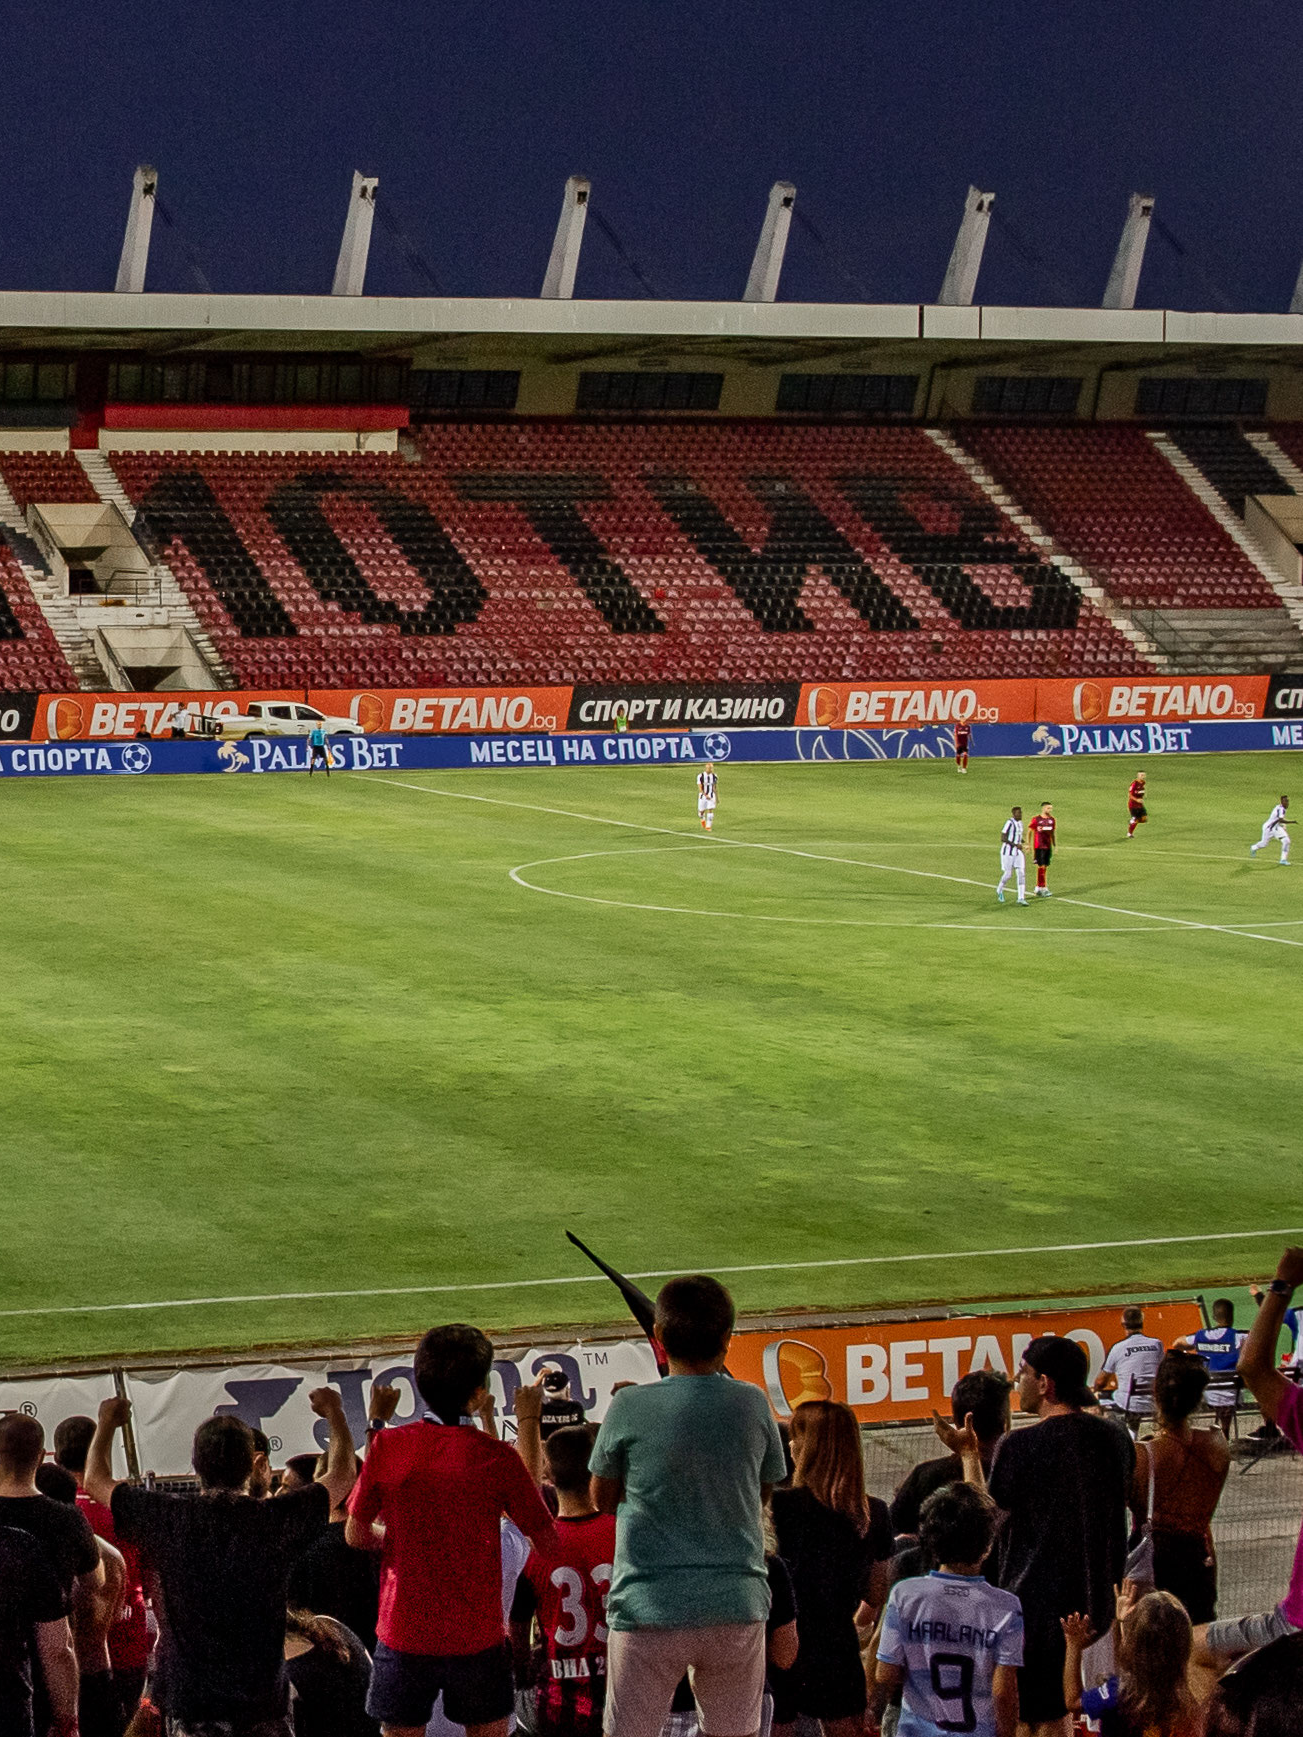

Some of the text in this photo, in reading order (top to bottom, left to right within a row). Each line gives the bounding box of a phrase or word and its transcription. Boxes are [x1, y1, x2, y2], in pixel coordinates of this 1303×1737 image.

[579, 697, 785, 722] СПОРТ И КАЗИНО
[11, 748, 112, 772] СПОРТА
[250, 739, 345, 773] PALS
[471, 737, 696, 766] МЕСЕЦ НА СПОРТА
[930, 1652, 977, 1733] 9
